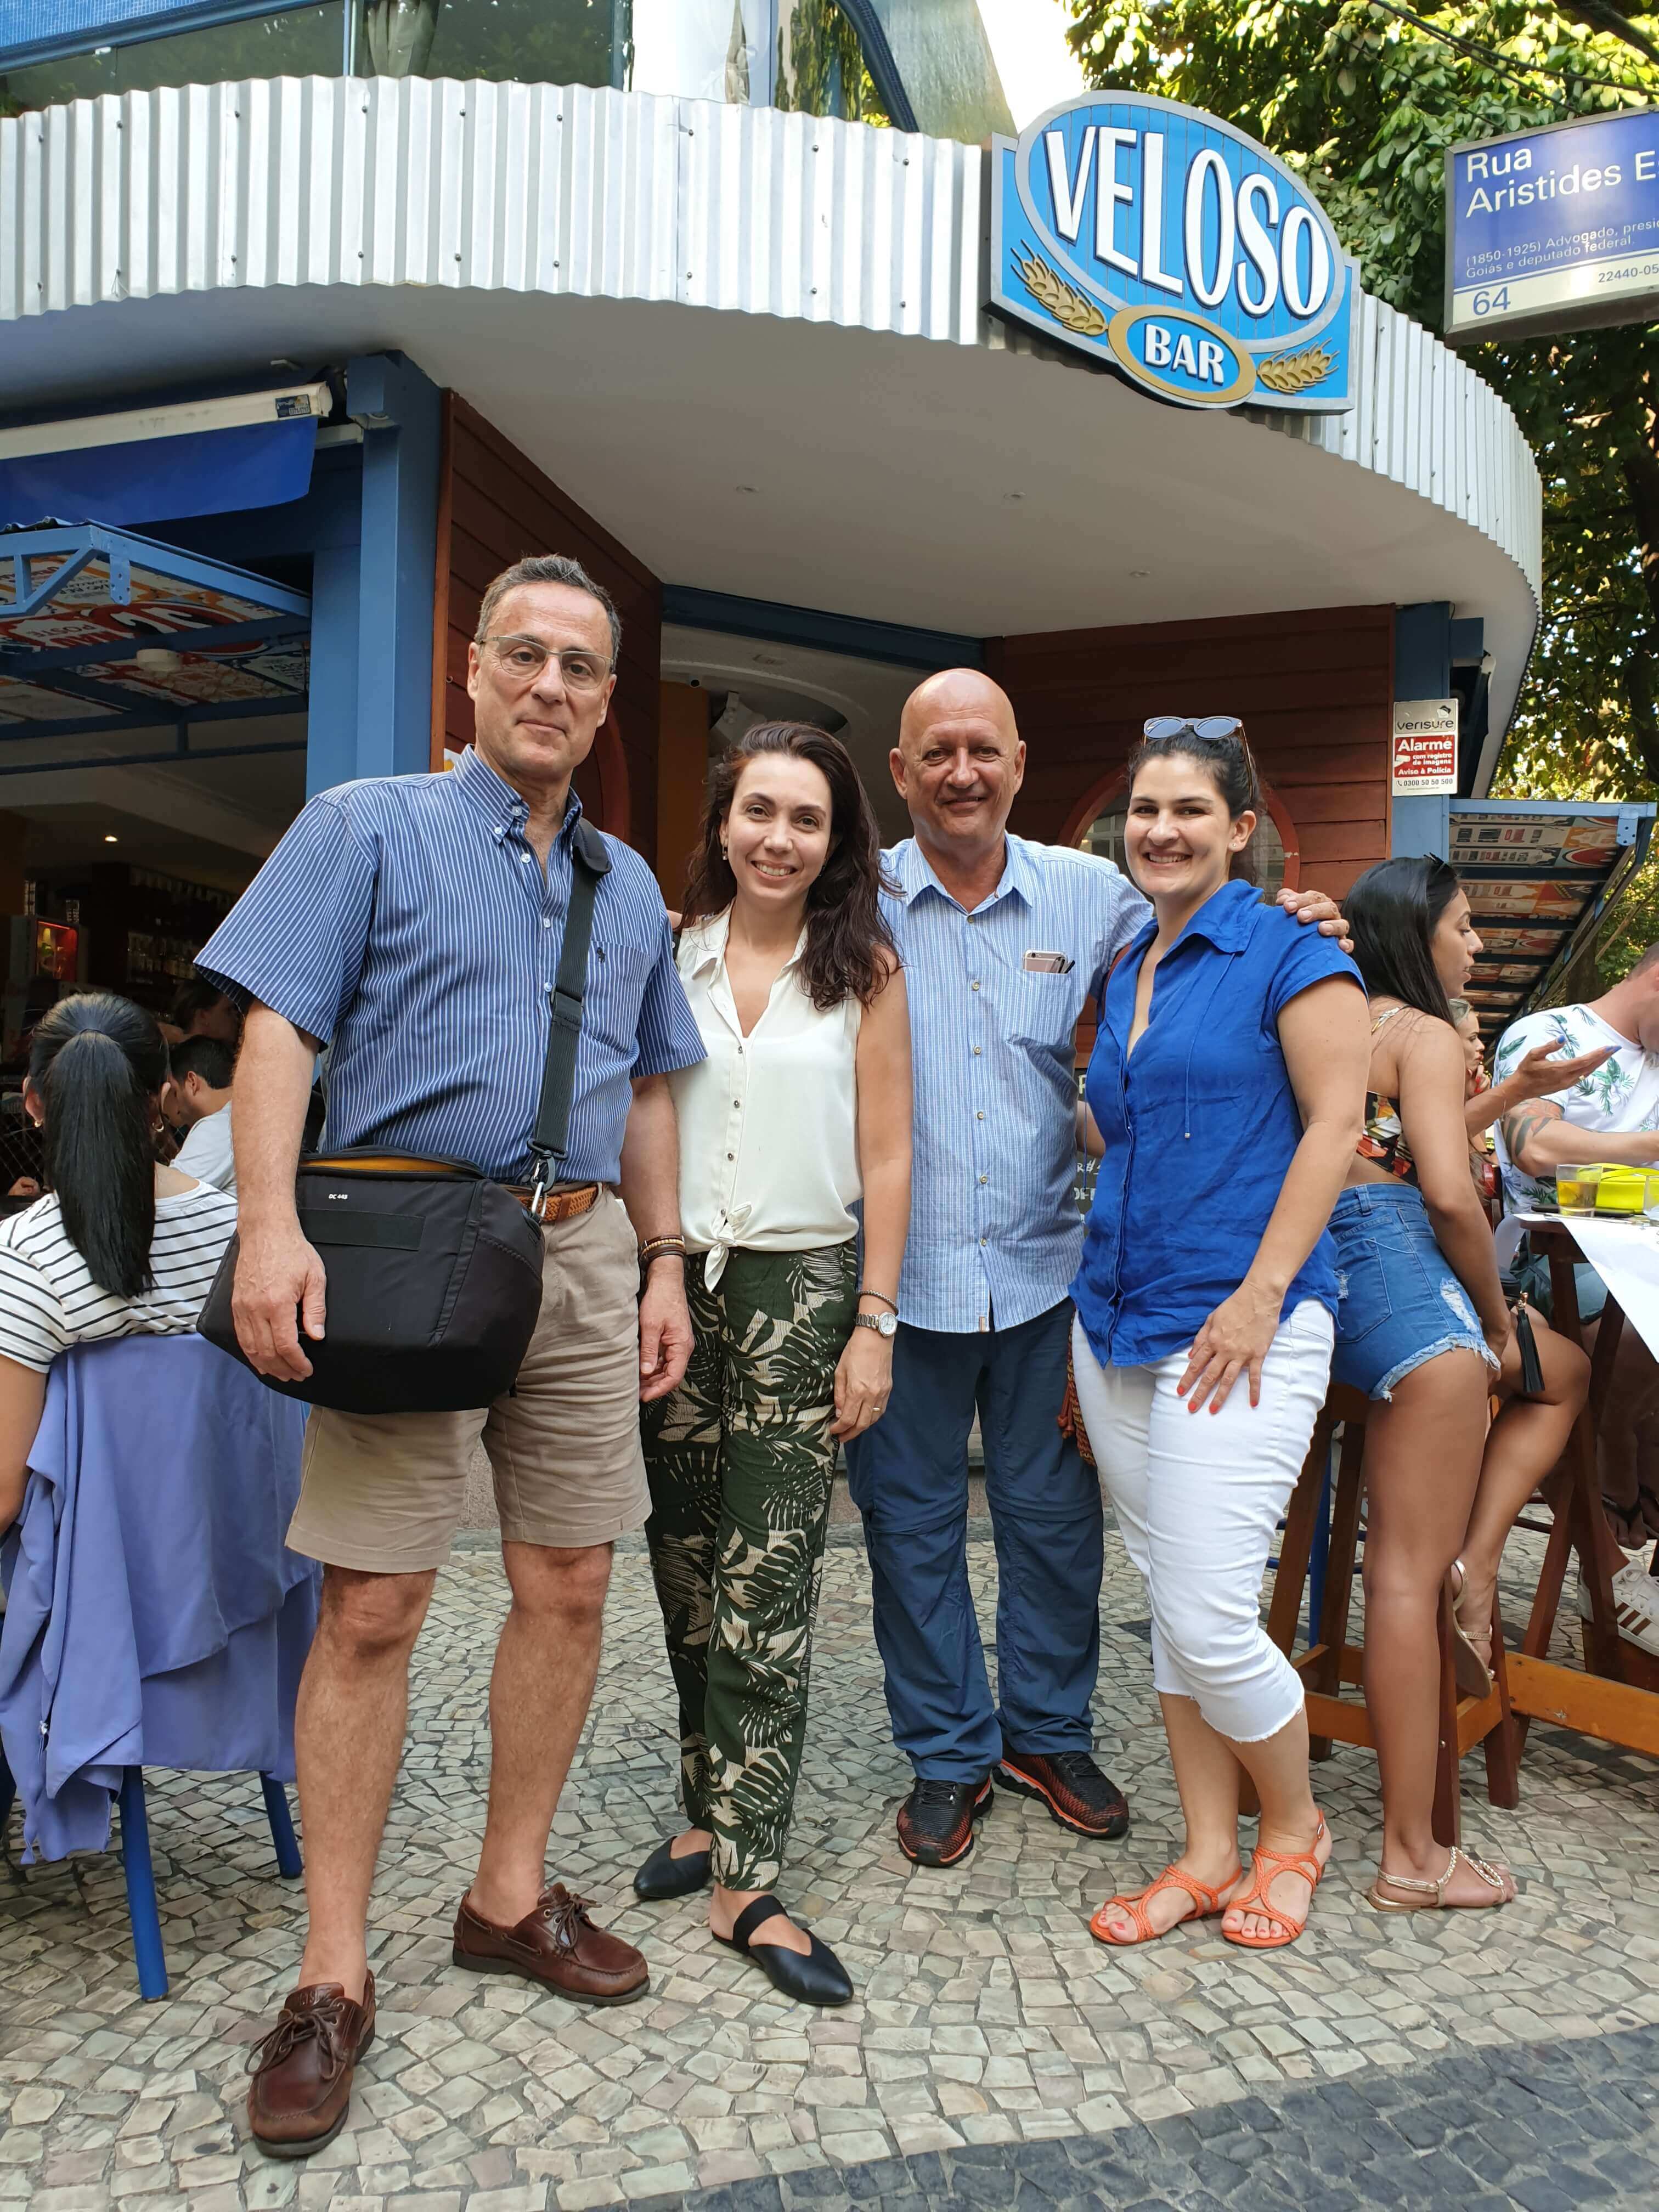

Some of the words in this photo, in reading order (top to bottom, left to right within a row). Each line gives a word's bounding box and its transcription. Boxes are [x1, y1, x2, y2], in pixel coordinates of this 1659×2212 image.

[1466, 148, 1533, 183] Rua
[1465, 165, 1622, 218] Aristides
[1635, 150, 1659, 180] E
[1045, 125, 1330, 320] VELOSO
[1466, 241, 1541, 268] (1850-1925)
[1545, 226, 1618, 248] Advogado,
[1466, 264, 1502, 278] Goiás
[1518, 244, 1581, 267] deputado
[1584, 235, 1635, 254] federal.
[1598, 263, 1659, 283] 22440-05
[1472, 286, 1511, 317] 64
[1143, 323, 1225, 385] BAR
[1397, 720, 1454, 730] verisure
[1397, 738, 1452, 752] Alarme
[1427, 752, 1452, 760] registro
